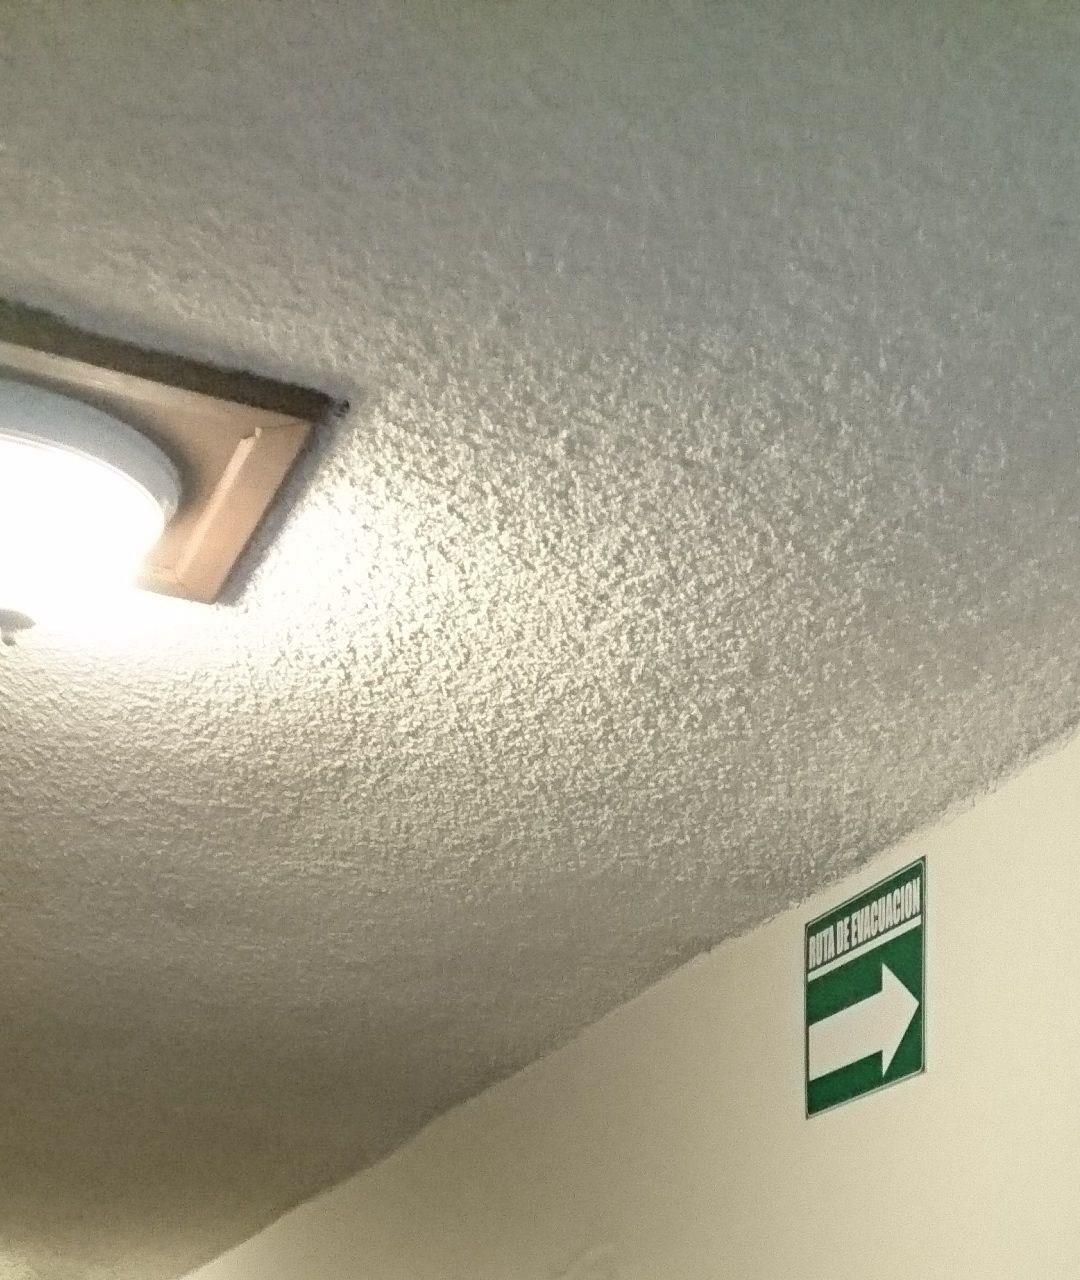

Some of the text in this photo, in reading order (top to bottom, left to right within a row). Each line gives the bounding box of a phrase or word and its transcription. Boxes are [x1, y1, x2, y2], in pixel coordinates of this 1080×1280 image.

[809, 877, 920, 968] RUTA DE EVACUACION
